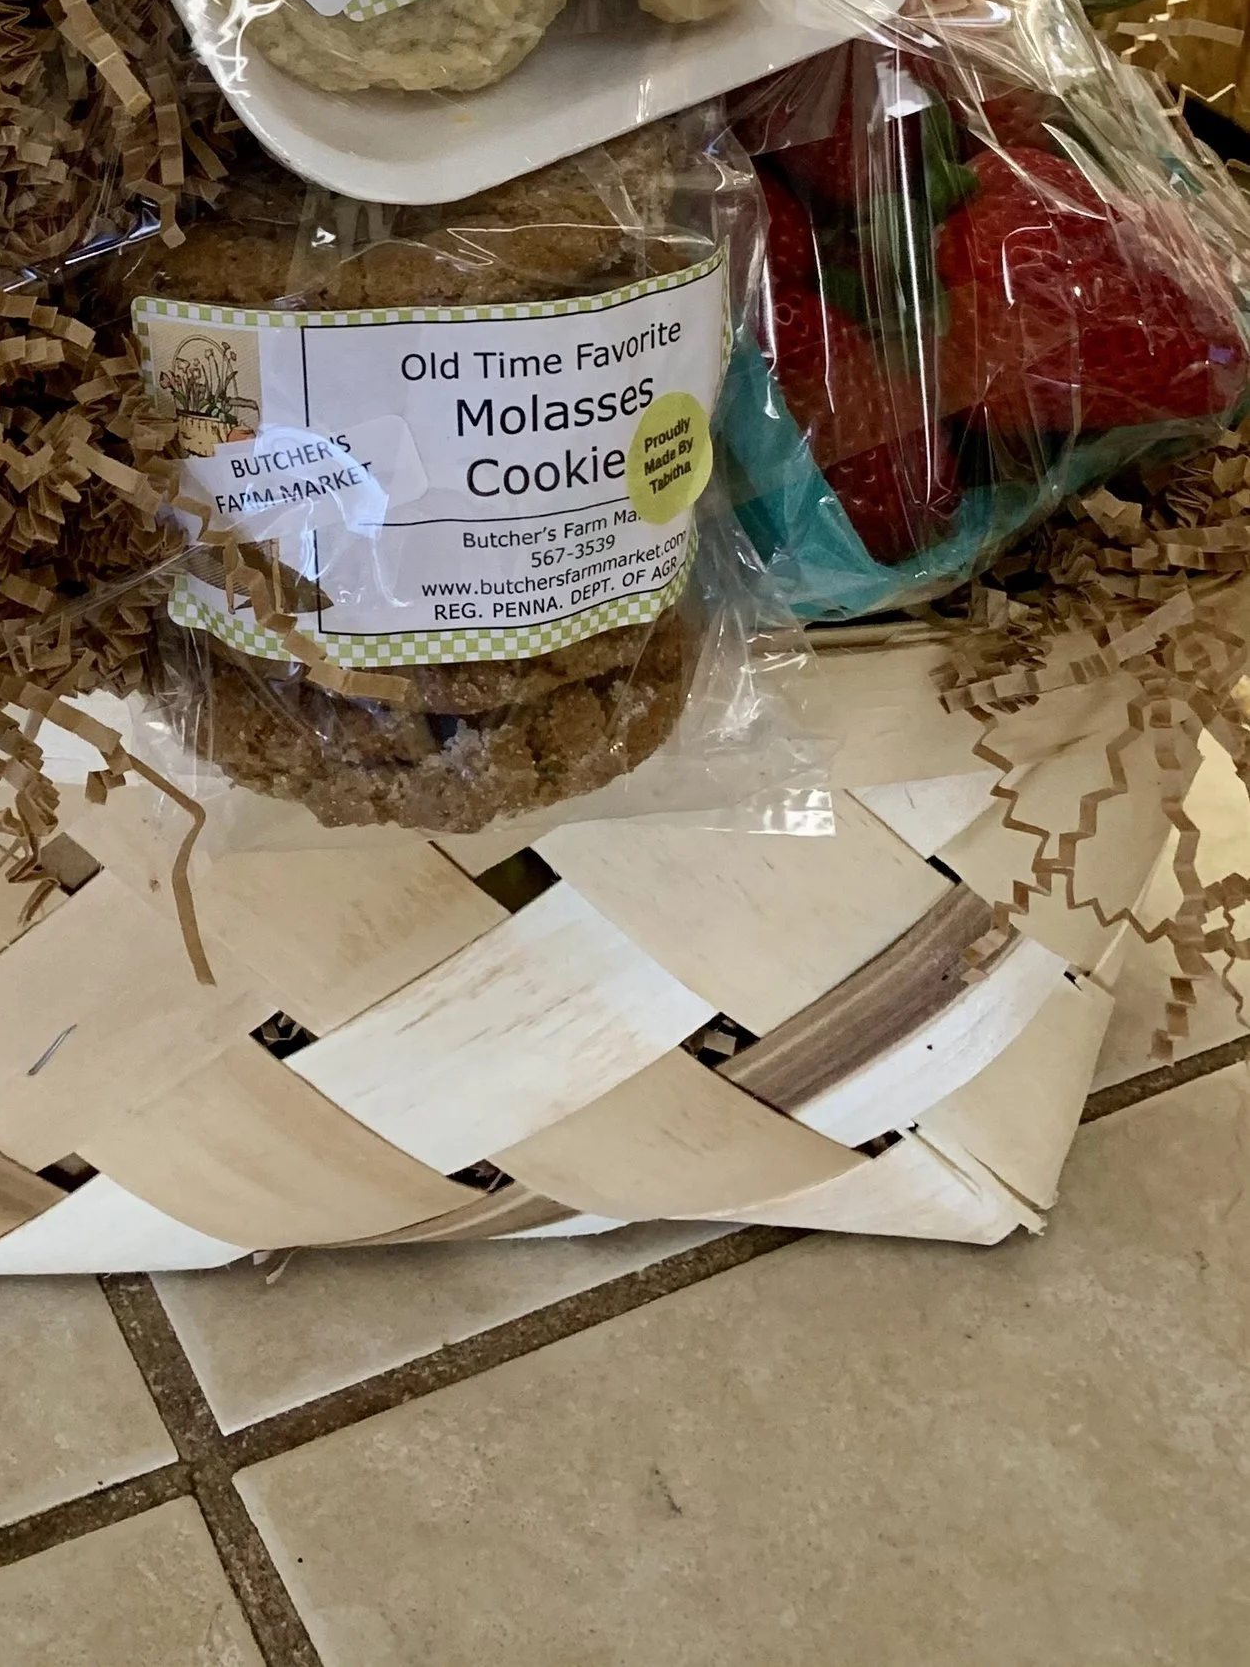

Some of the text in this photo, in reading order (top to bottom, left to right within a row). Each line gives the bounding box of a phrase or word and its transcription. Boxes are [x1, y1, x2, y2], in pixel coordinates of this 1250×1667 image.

[401, 321, 682, 381] Old Time Favorite
[456, 377, 654, 437] Molasses
[643, 416, 691, 453] Proudly
[230, 434, 352, 479] BUTCHER'S
[643, 436, 694, 476] Made By
[279, 461, 373, 504] MARKET
[648, 459, 692, 495] Tabitha
[462, 525, 557, 549] Butcher's
[563, 518, 608, 539] Farm
[530, 534, 616, 568] 567-3539
[434, 602, 483, 621] REG.
[492, 595, 564, 619] PENNA.
[570, 578, 615, 606] DEPT.
[622, 569, 647, 588] OF
